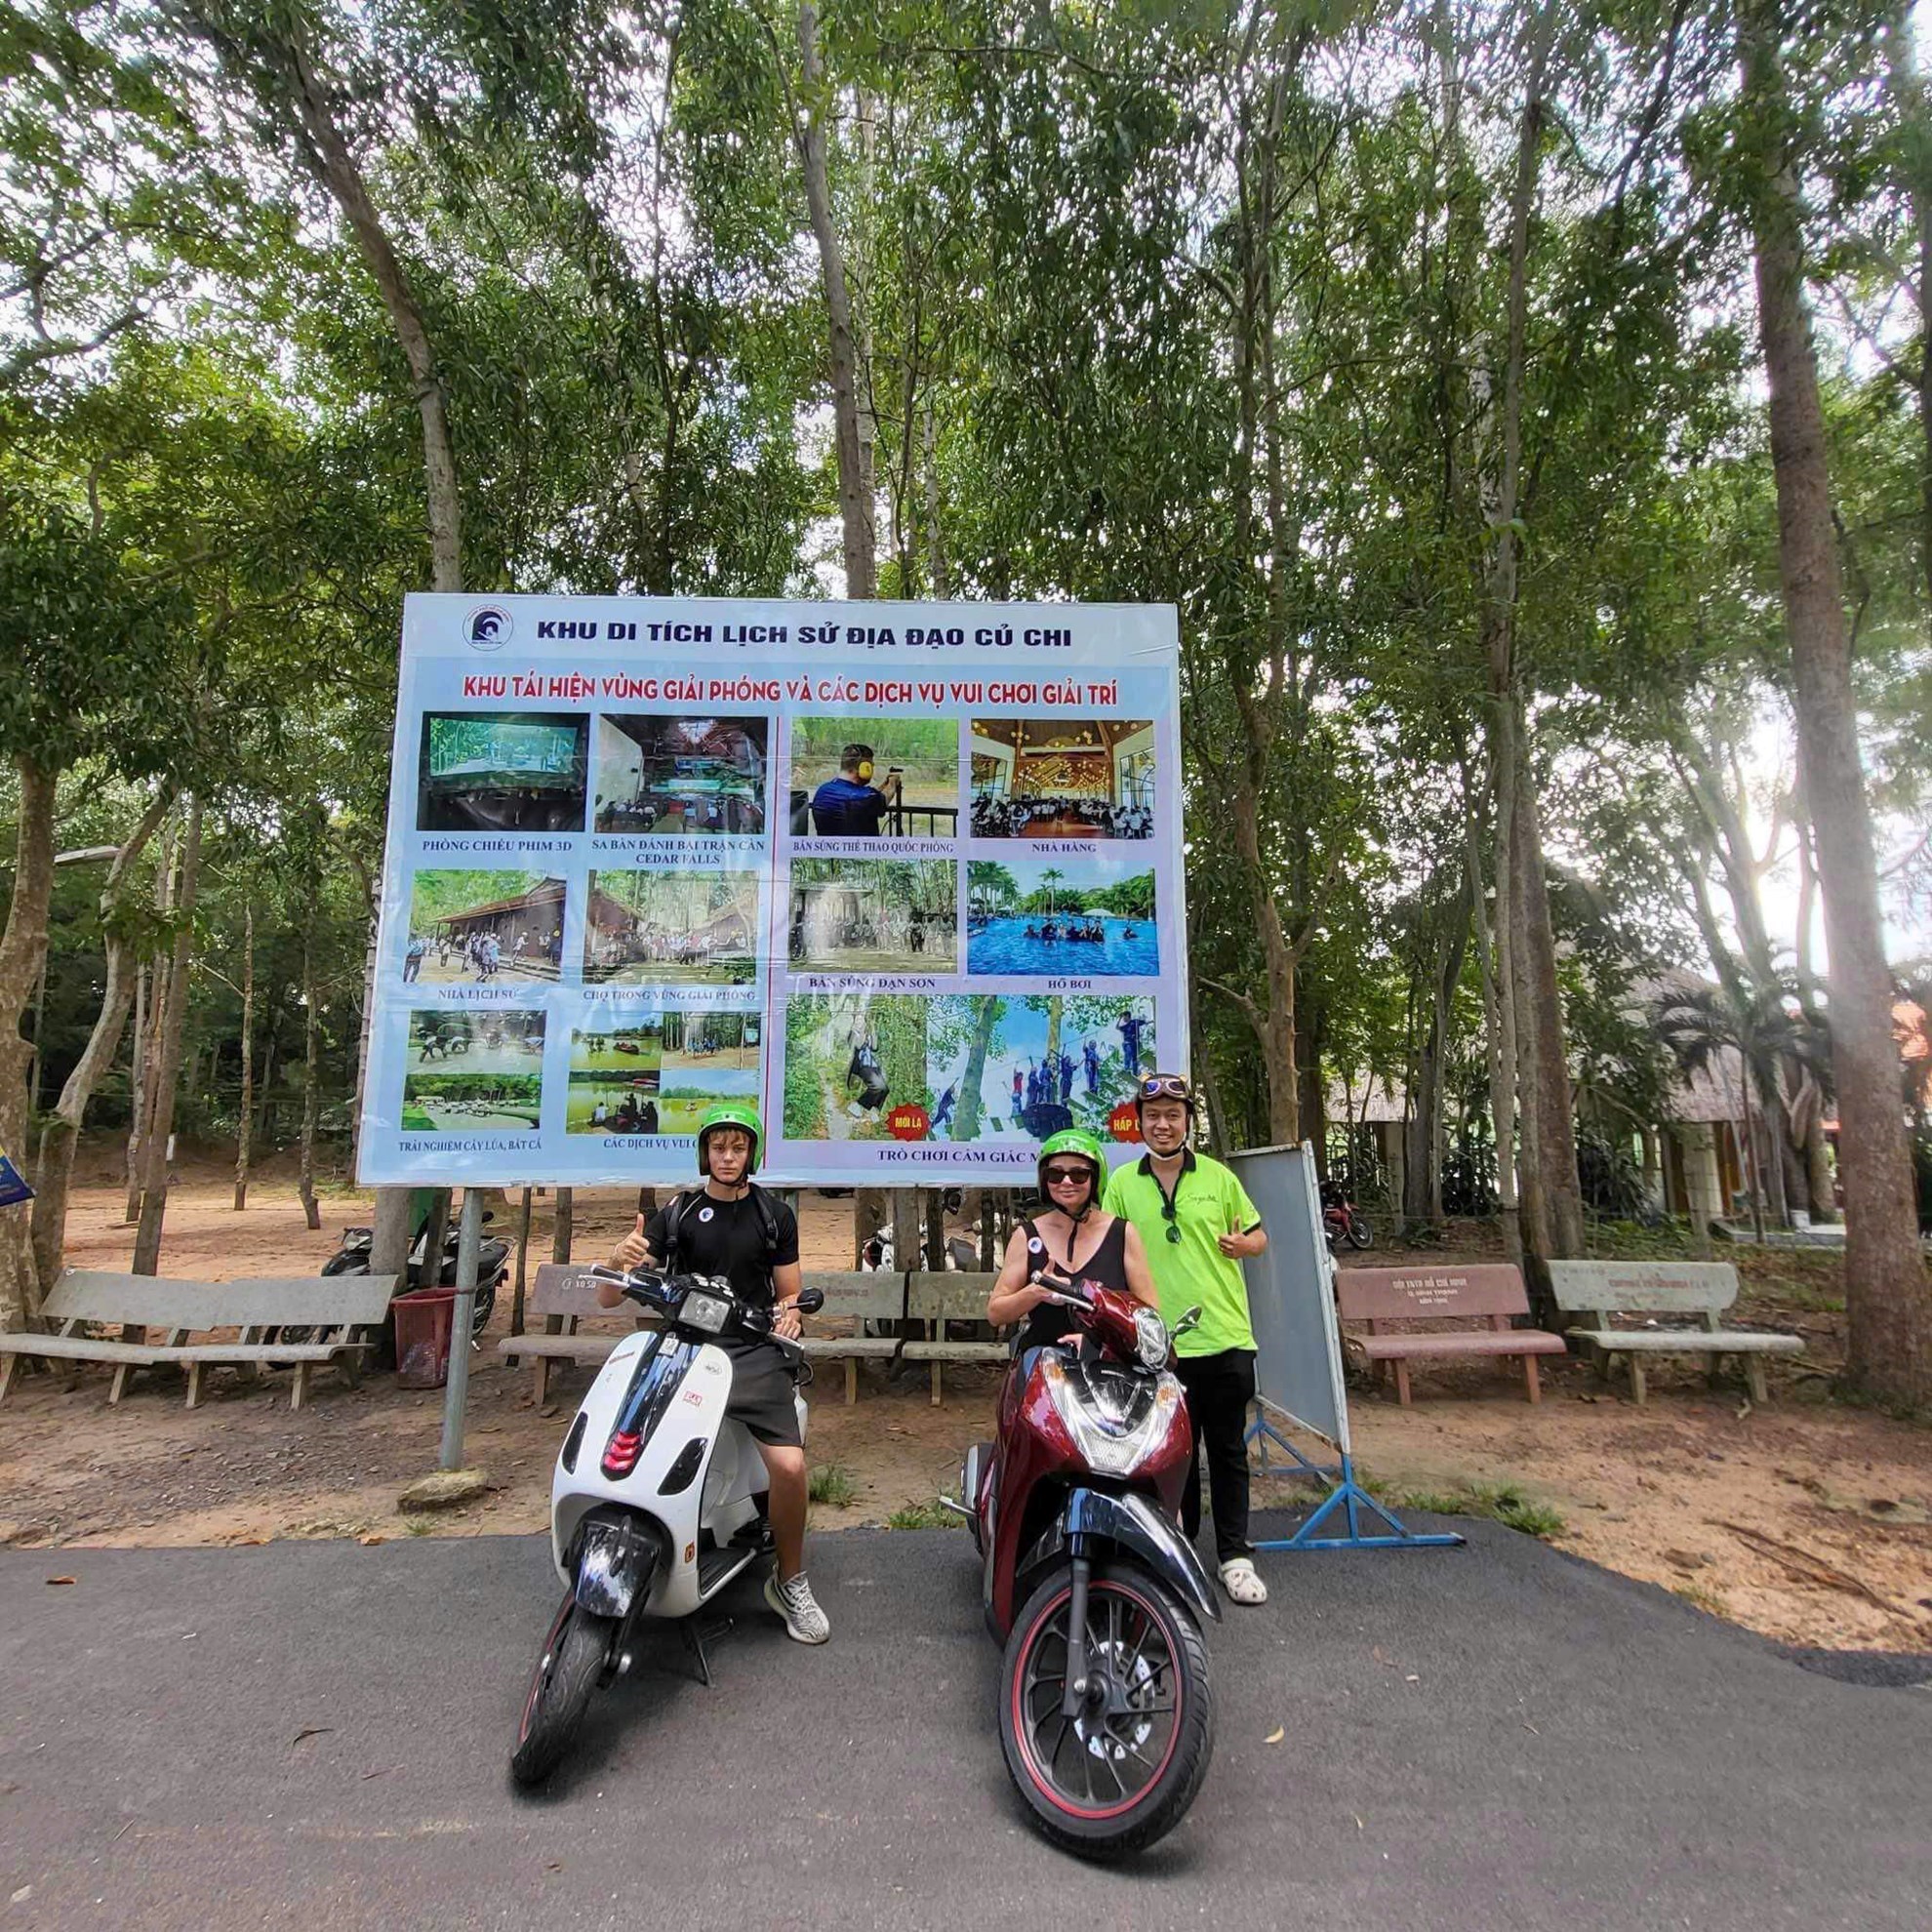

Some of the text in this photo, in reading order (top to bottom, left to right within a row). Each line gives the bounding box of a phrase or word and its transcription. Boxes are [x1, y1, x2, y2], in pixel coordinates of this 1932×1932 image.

[538, 621, 1071, 650] KHU DI TÍCH LỊCH SỬ ĐỊA ĐẠO CỦ CHI
[463, 668, 1117, 709] KHU TÁI HIỆN VÙNG GIẢI PHÓNG VÀ CÁC DỊCH VỤ VUI CHƠI GIẢI TRÍ
[423, 838, 573, 852] PHÒNG CHIẾU PHIM 3D
[591, 839, 607, 850] SA
[610, 837, 635, 850] BÀN
[639, 837, 673, 850] ĐÁNH
[677, 840, 699, 852] BẠI
[814, 839, 839, 851] SÚNG
[863, 841, 889, 852] THAO
[920, 840, 953, 853] PHÒNG
[1032, 841, 1096, 852] NHÀ HÀNG
[635, 854, 720, 865] CEDAR FALLS
[839, 976, 875, 987] SÚNG
[878, 979, 906, 990] ĐẠN
[908, 979, 936, 987] SƠN
[1069, 980, 1092, 989] BƠI
[439, 987, 464, 999] NHÀ
[468, 989, 498, 1001] LỊCH
[611, 990, 650, 1000] TRONG
[895, 1115, 922, 1131] MỚI LẠ
[1113, 1115, 1132, 1131] HẤP
[528, 1136, 542, 1149] CÁ
[603, 1137, 625, 1148] CÁC
[627, 1139, 653, 1150] DỊCH
[655, 1139, 669, 1150] VỤ
[671, 1139, 692, 1148] VUI
[878, 1147, 907, 1161] TRÒ
[911, 1149, 948, 1161] CHƠI
[989, 1148, 1026, 1162] GIÁC
